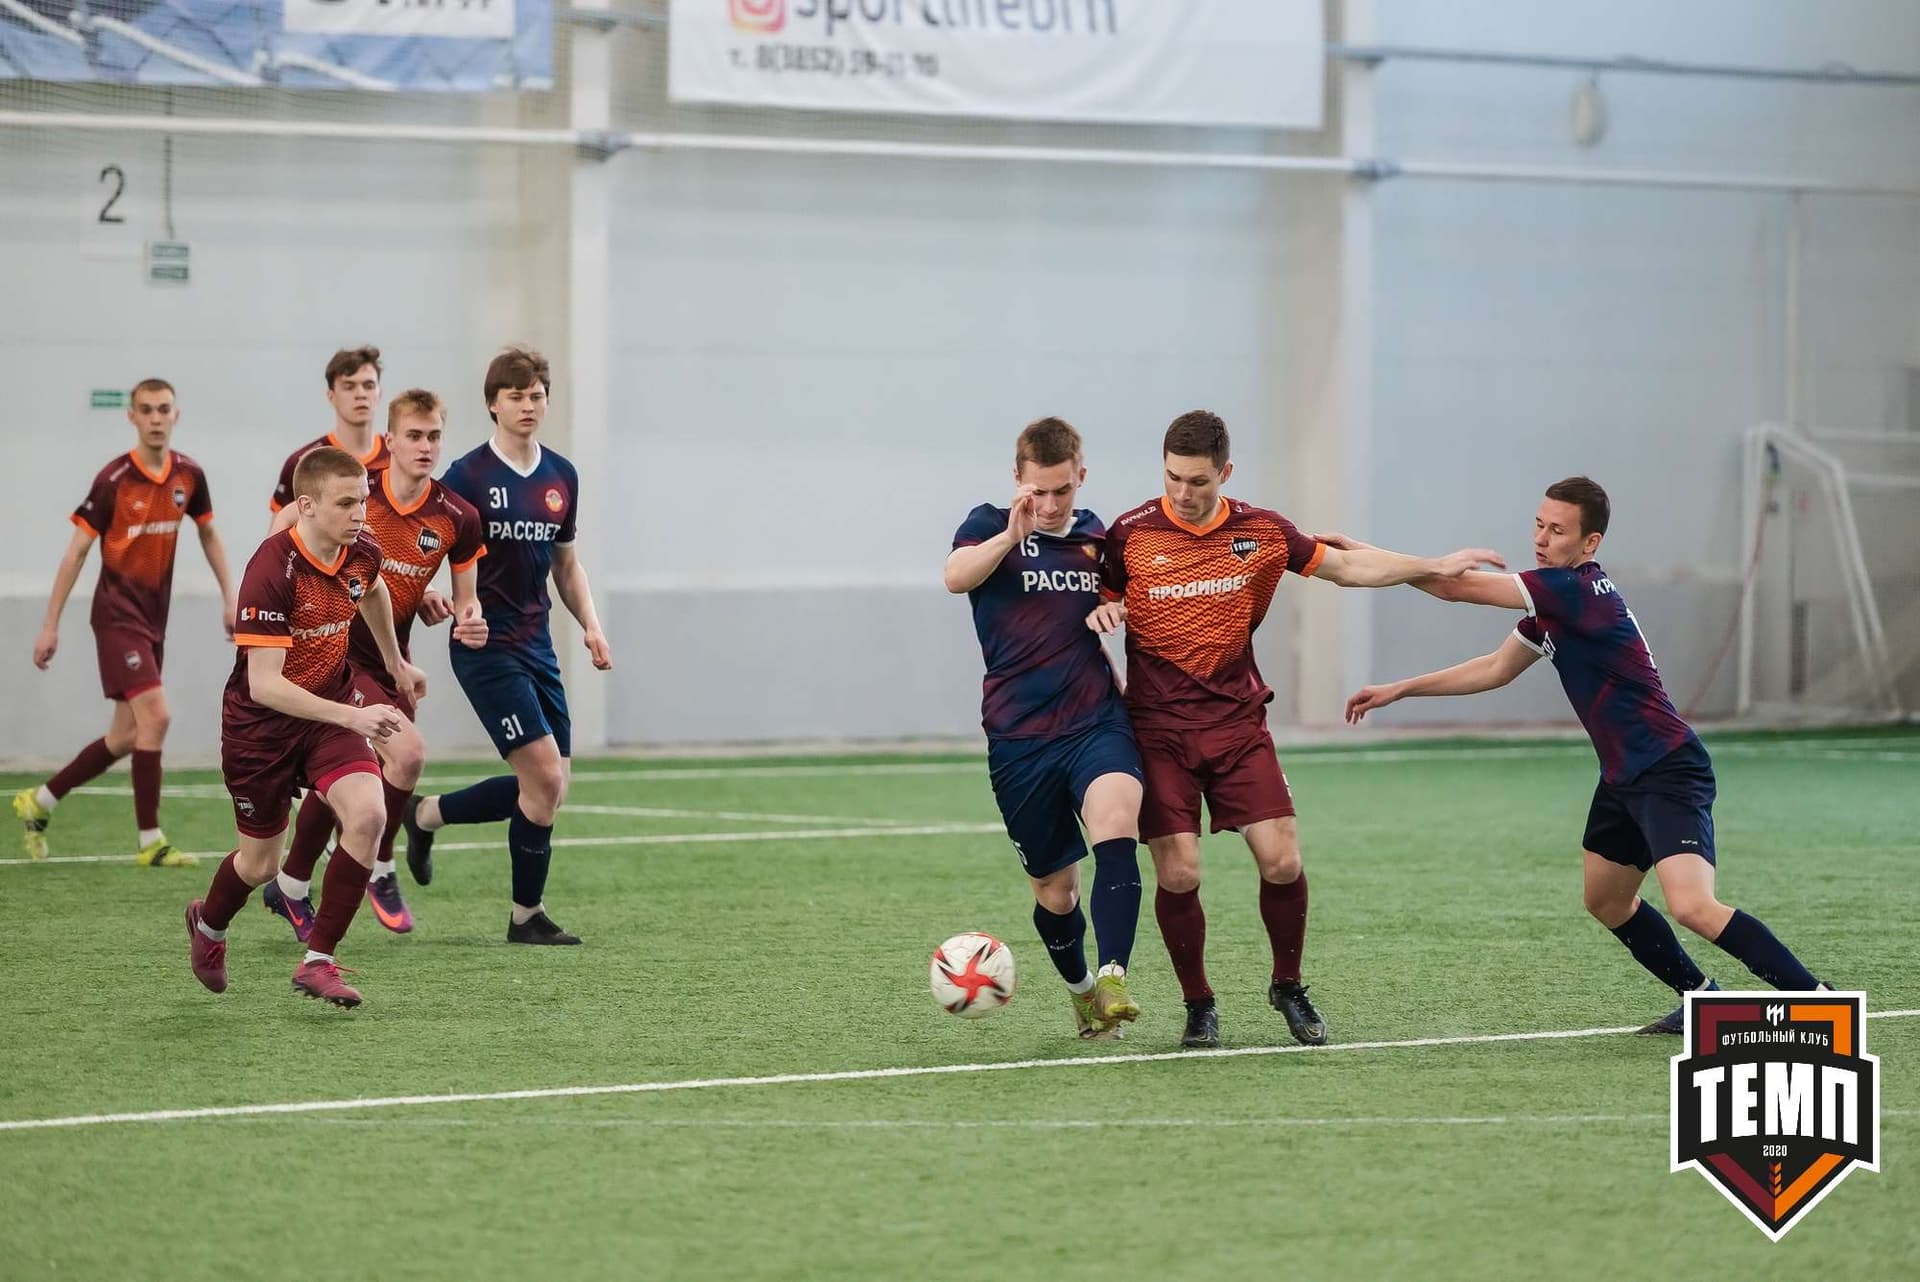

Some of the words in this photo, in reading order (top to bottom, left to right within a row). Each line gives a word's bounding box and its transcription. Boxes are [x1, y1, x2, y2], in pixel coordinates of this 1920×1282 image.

[99, 165, 125, 223] 2
[489, 486, 509, 509] 31
[1022, 570, 1100, 593] РАССВЕ
[1148, 572, 1257, 601] ПРОДИНВЕС
[259, 610, 285, 622] ПСБ
[501, 713, 524, 740] 31
